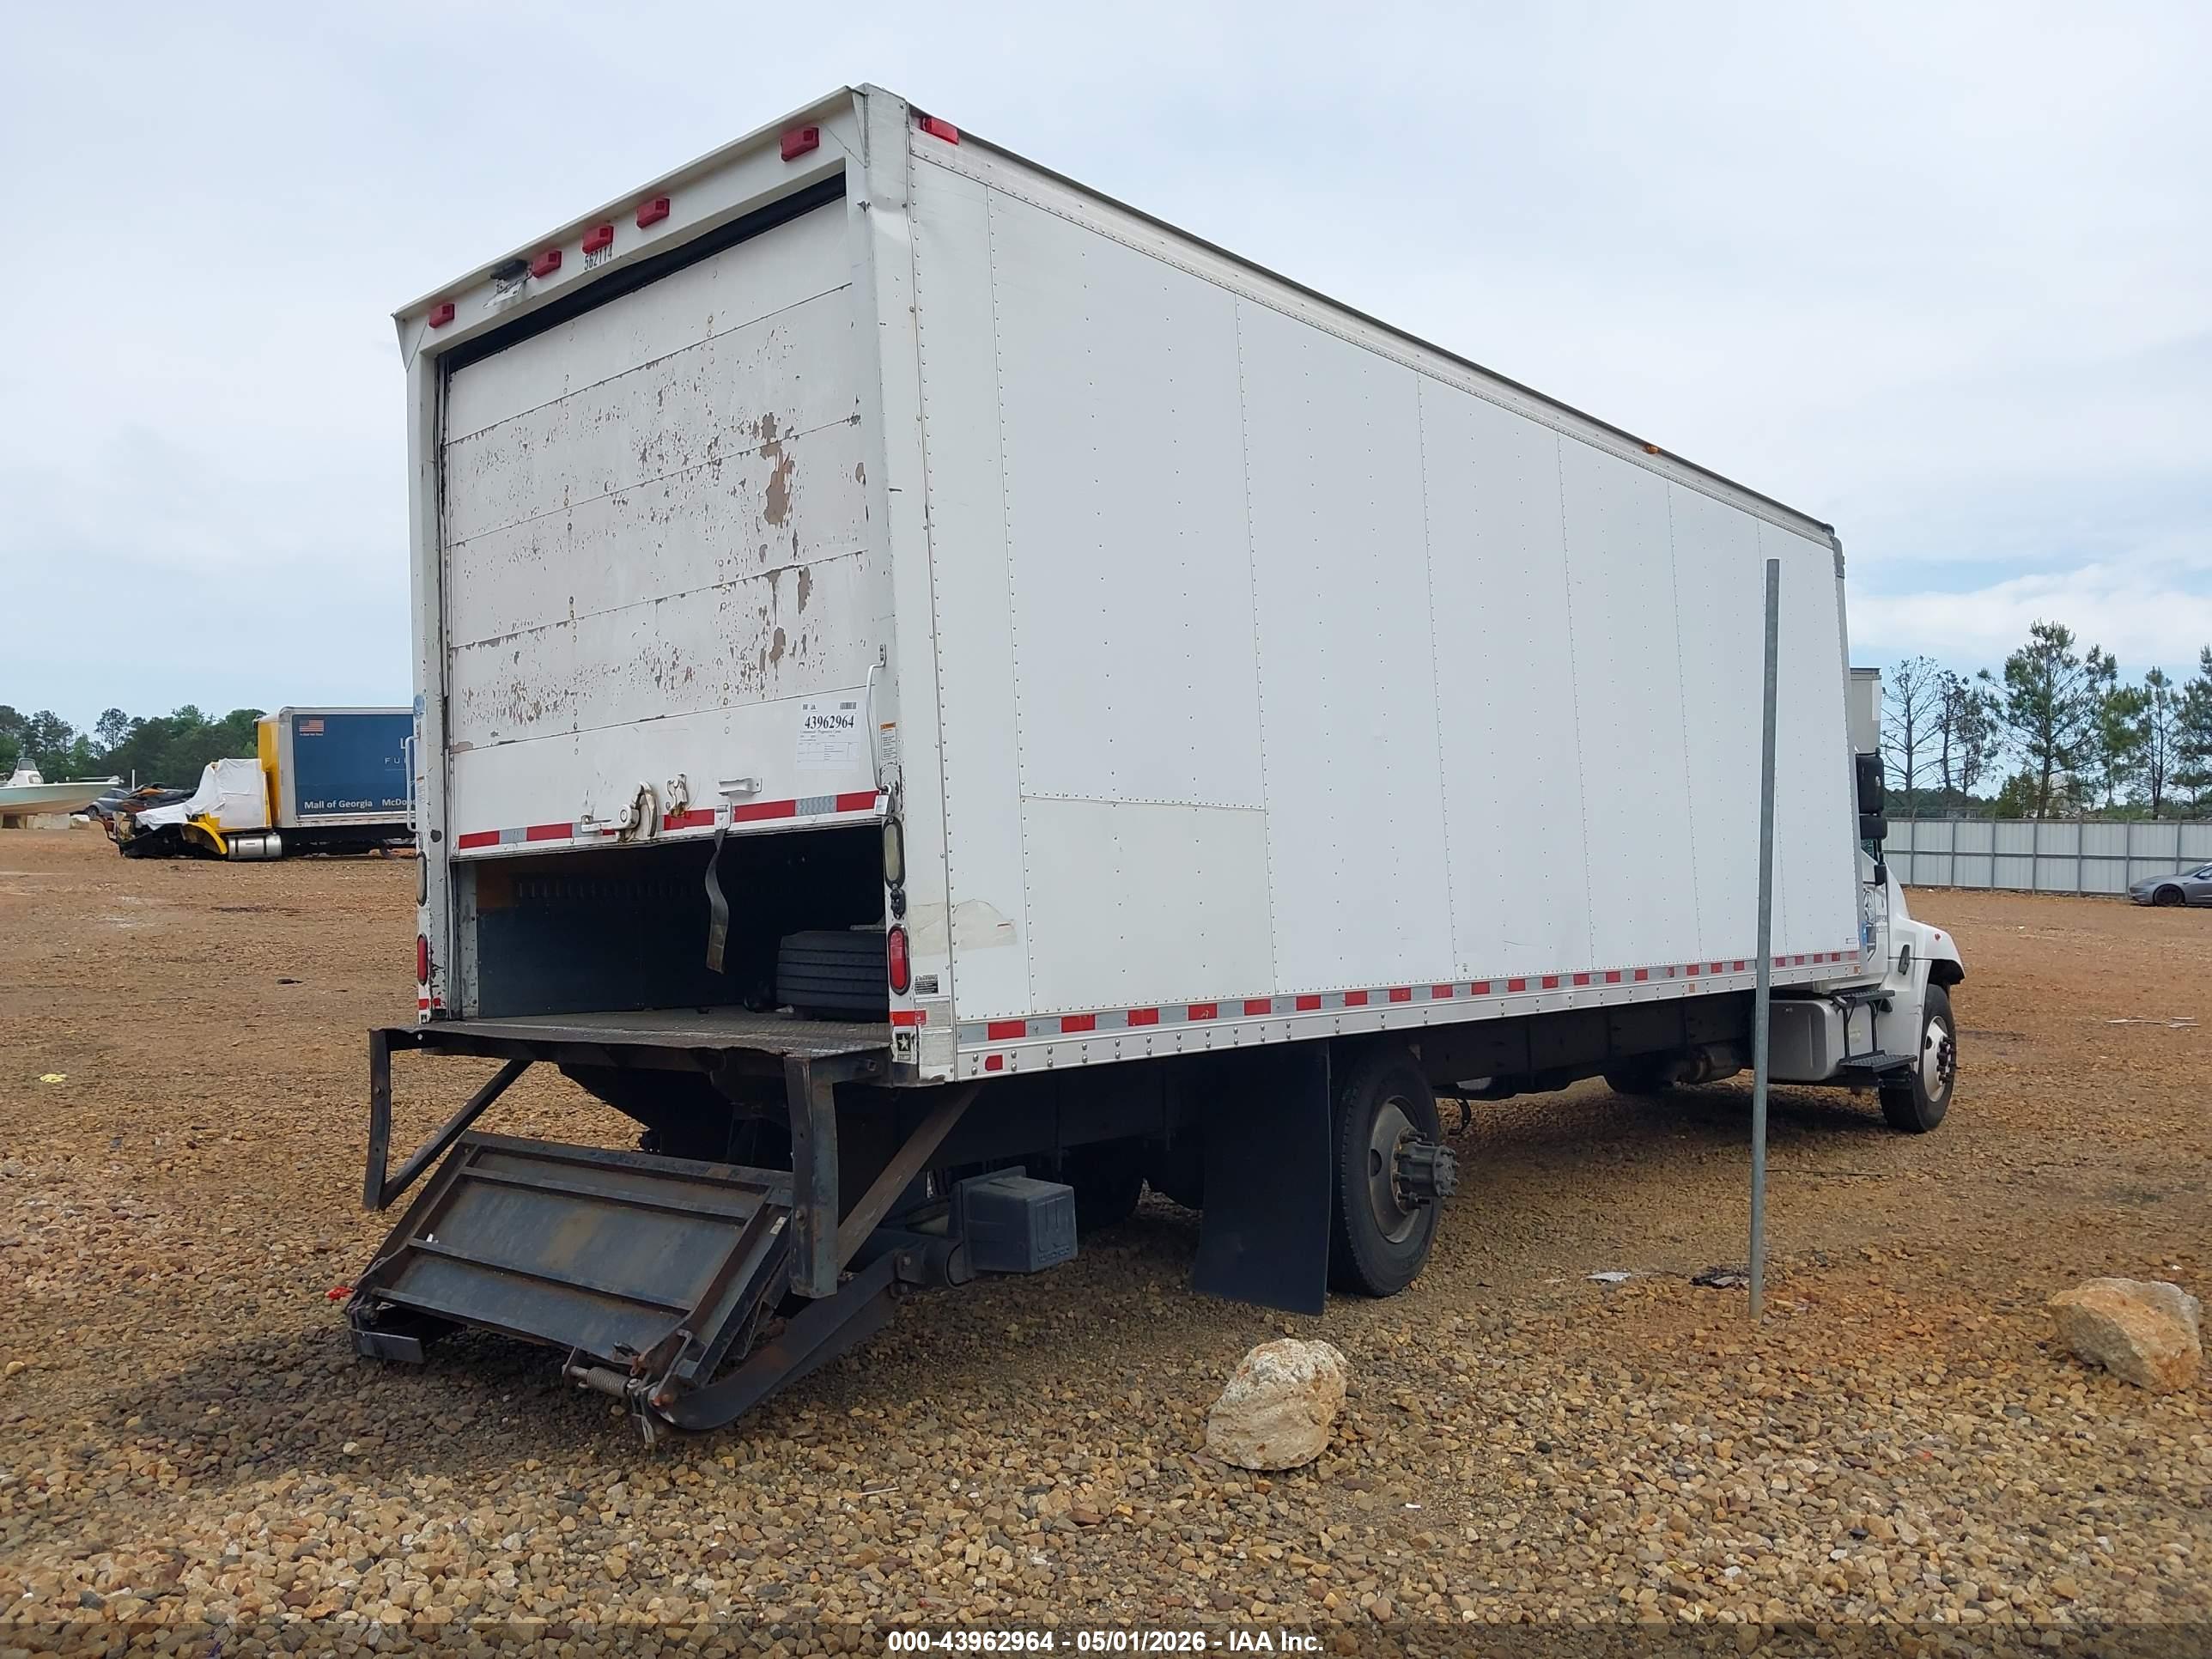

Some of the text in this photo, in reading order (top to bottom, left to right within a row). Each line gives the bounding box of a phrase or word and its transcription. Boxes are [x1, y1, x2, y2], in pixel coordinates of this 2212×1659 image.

[584, 244, 612, 270] 562114
[805, 714, 854, 729] 43962964
[304, 799, 373, 810] Mall of Georgia
